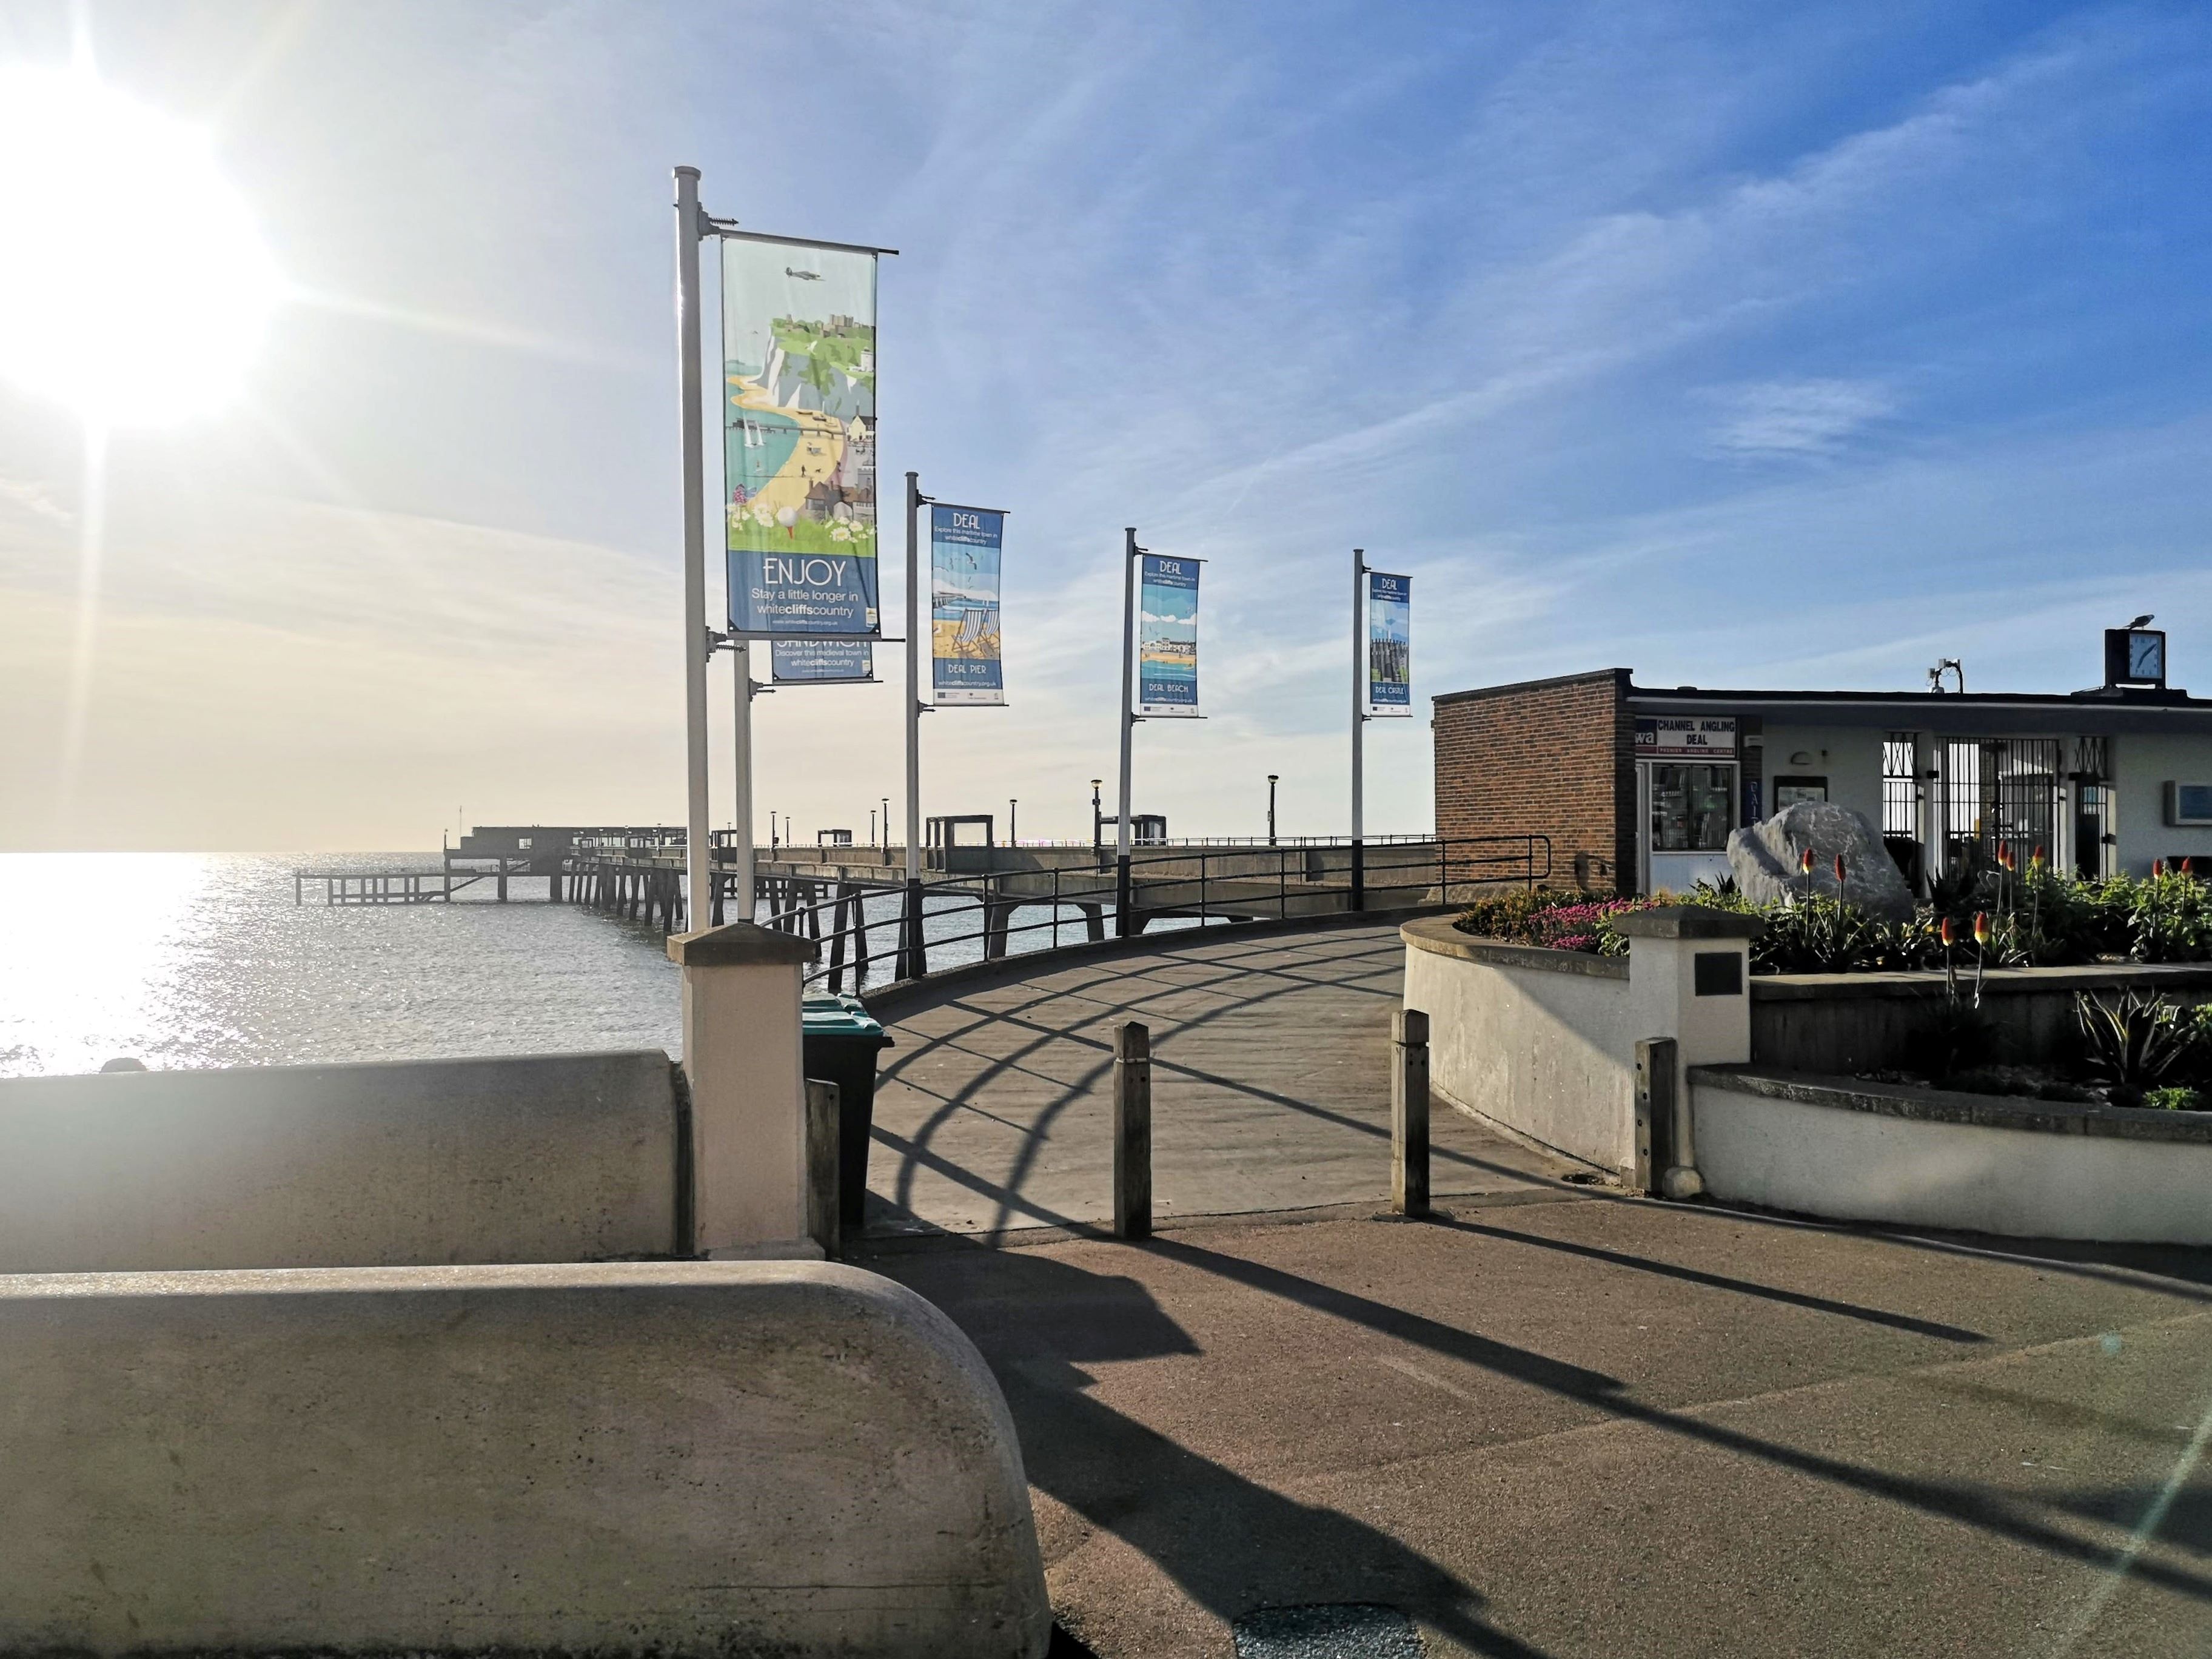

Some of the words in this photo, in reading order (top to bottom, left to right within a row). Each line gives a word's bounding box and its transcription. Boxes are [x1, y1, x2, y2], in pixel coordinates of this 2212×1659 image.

[953, 512, 980, 529] DEAL
[945, 535, 987, 546] whitecliffscountry
[763, 558, 846, 586] ENJOY
[1159, 560, 1182, 575] DEAL
[1381, 578, 1398, 591] DEAL
[751, 588, 775, 600] Stay
[778, 591, 785, 600] a
[788, 589, 809, 600] little
[812, 590, 846, 603] longer
[849, 591, 859, 602] in
[757, 604, 854, 618] whitecliffscountry
[791, 658, 855, 667] whitecliffscountry
[948, 664, 967, 674] DEAL
[970, 665, 987, 674] PIER
[1148, 683, 1165, 692] DEAL
[1167, 684, 1189, 693] BEACH
[1658, 720, 1695, 731] CHANNEL
[1700, 720, 1735, 732] ANGLING
[1686, 734, 1708, 745] DEAL
